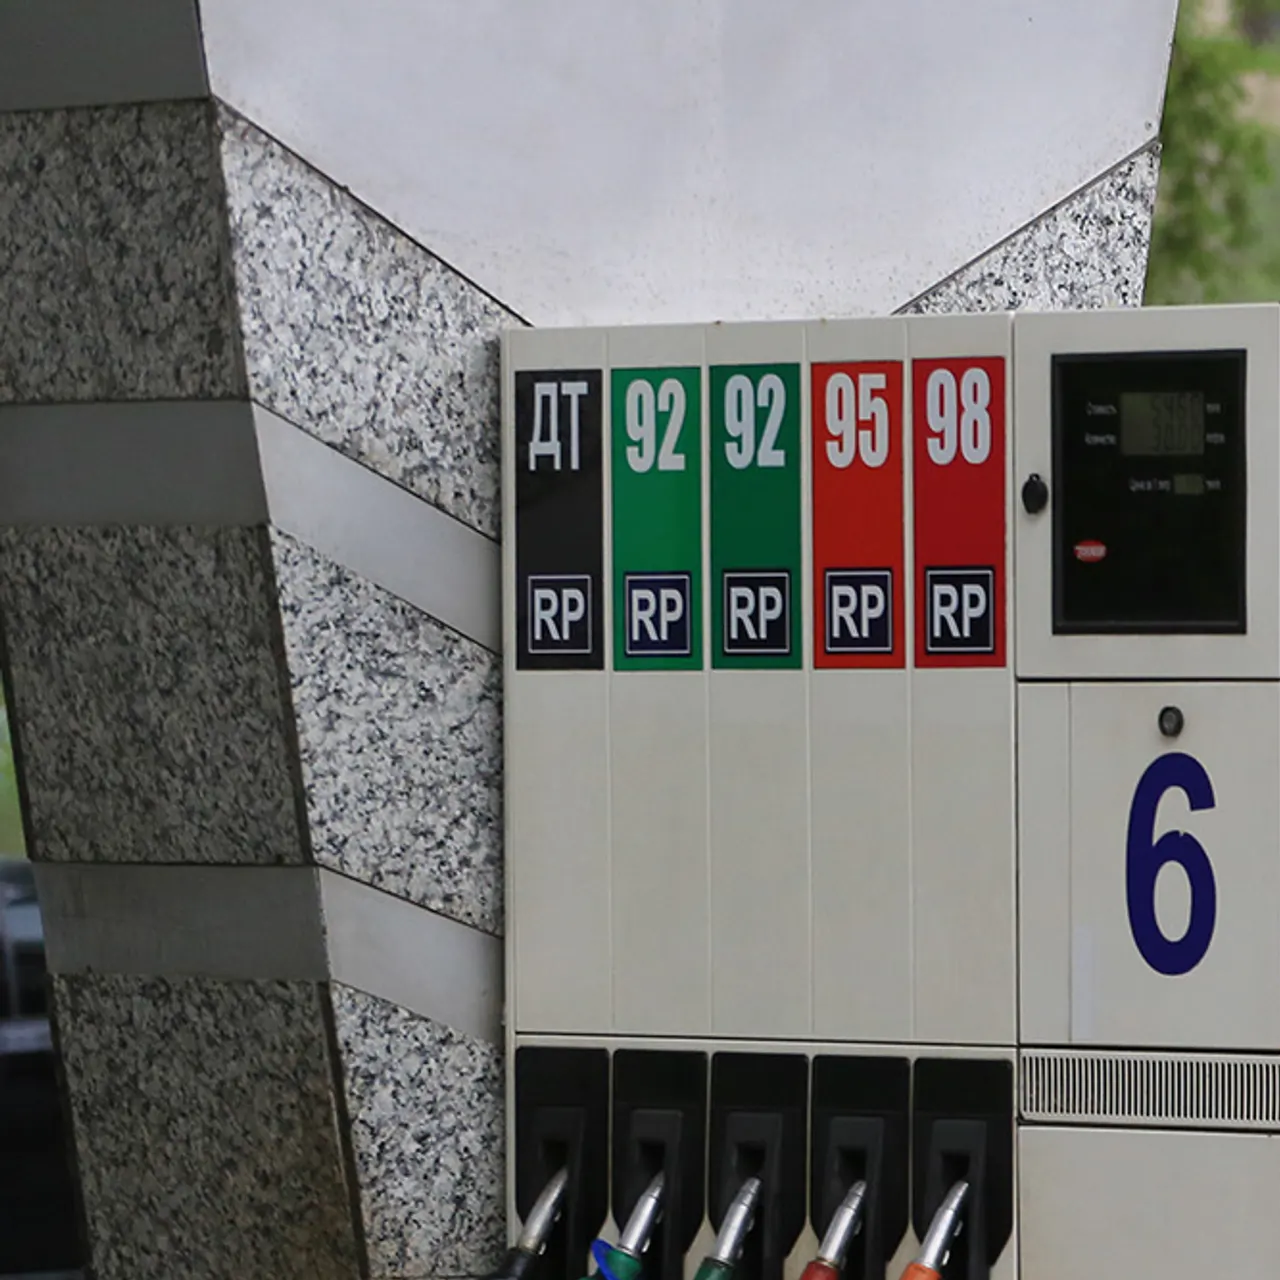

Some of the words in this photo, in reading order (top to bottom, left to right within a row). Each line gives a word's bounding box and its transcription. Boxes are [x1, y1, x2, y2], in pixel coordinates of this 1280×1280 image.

[528, 381, 588, 471] ДТ
[625, 377, 687, 473] 92
[724, 373, 786, 470] 92
[825, 371, 889, 469] 95
[926, 367, 992, 465] 98
[534, 588, 585, 641] RP
[632, 588, 683, 641] RP
[730, 586, 783, 640] RP
[831, 585, 885, 638] RP
[933, 583, 987, 638] RP
[1126, 752, 1217, 976] 6
